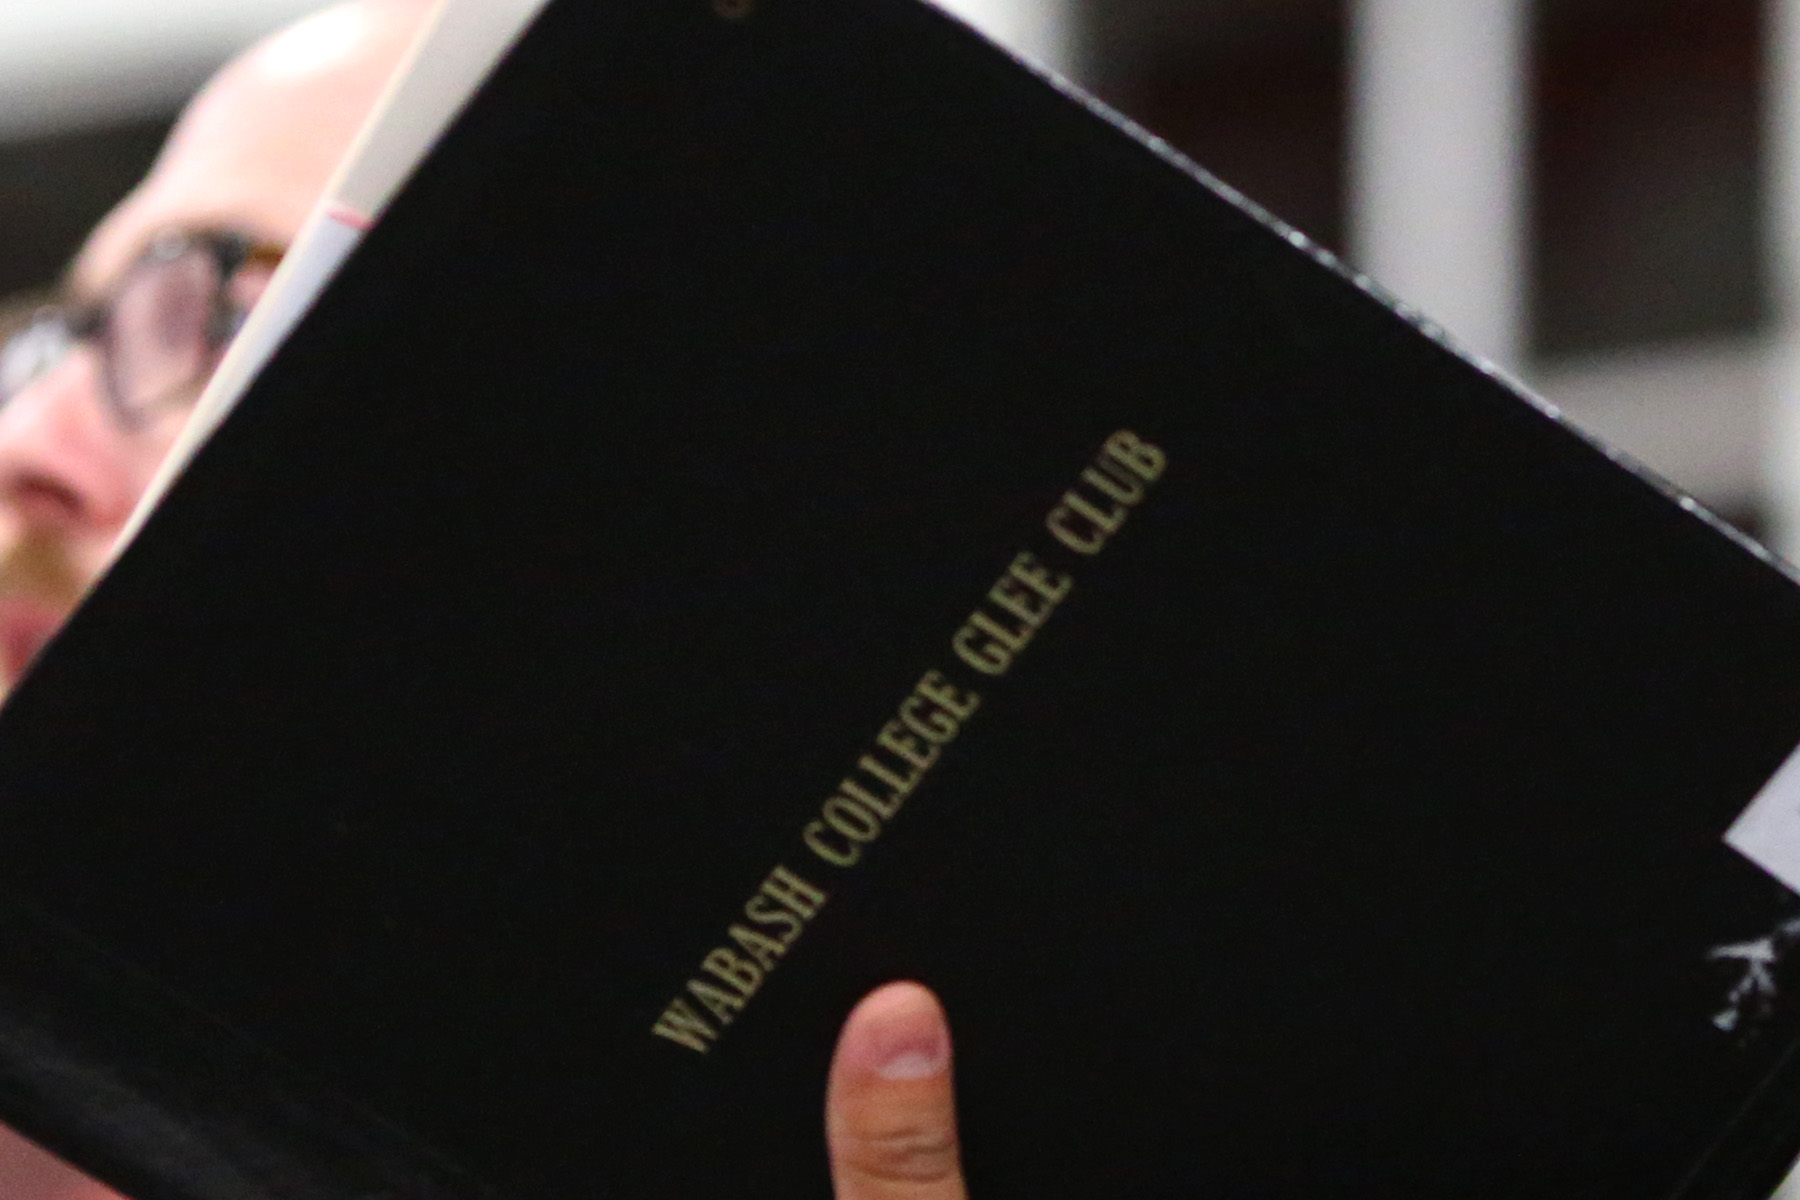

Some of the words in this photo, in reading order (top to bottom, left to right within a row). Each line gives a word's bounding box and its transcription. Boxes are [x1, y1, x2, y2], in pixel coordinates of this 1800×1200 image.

[652, 866, 826, 1052] WABASH
[804, 671, 979, 867] COLLEGE
[953, 553, 1071, 675] GLEE
[1047, 431, 1166, 554] CLUB
